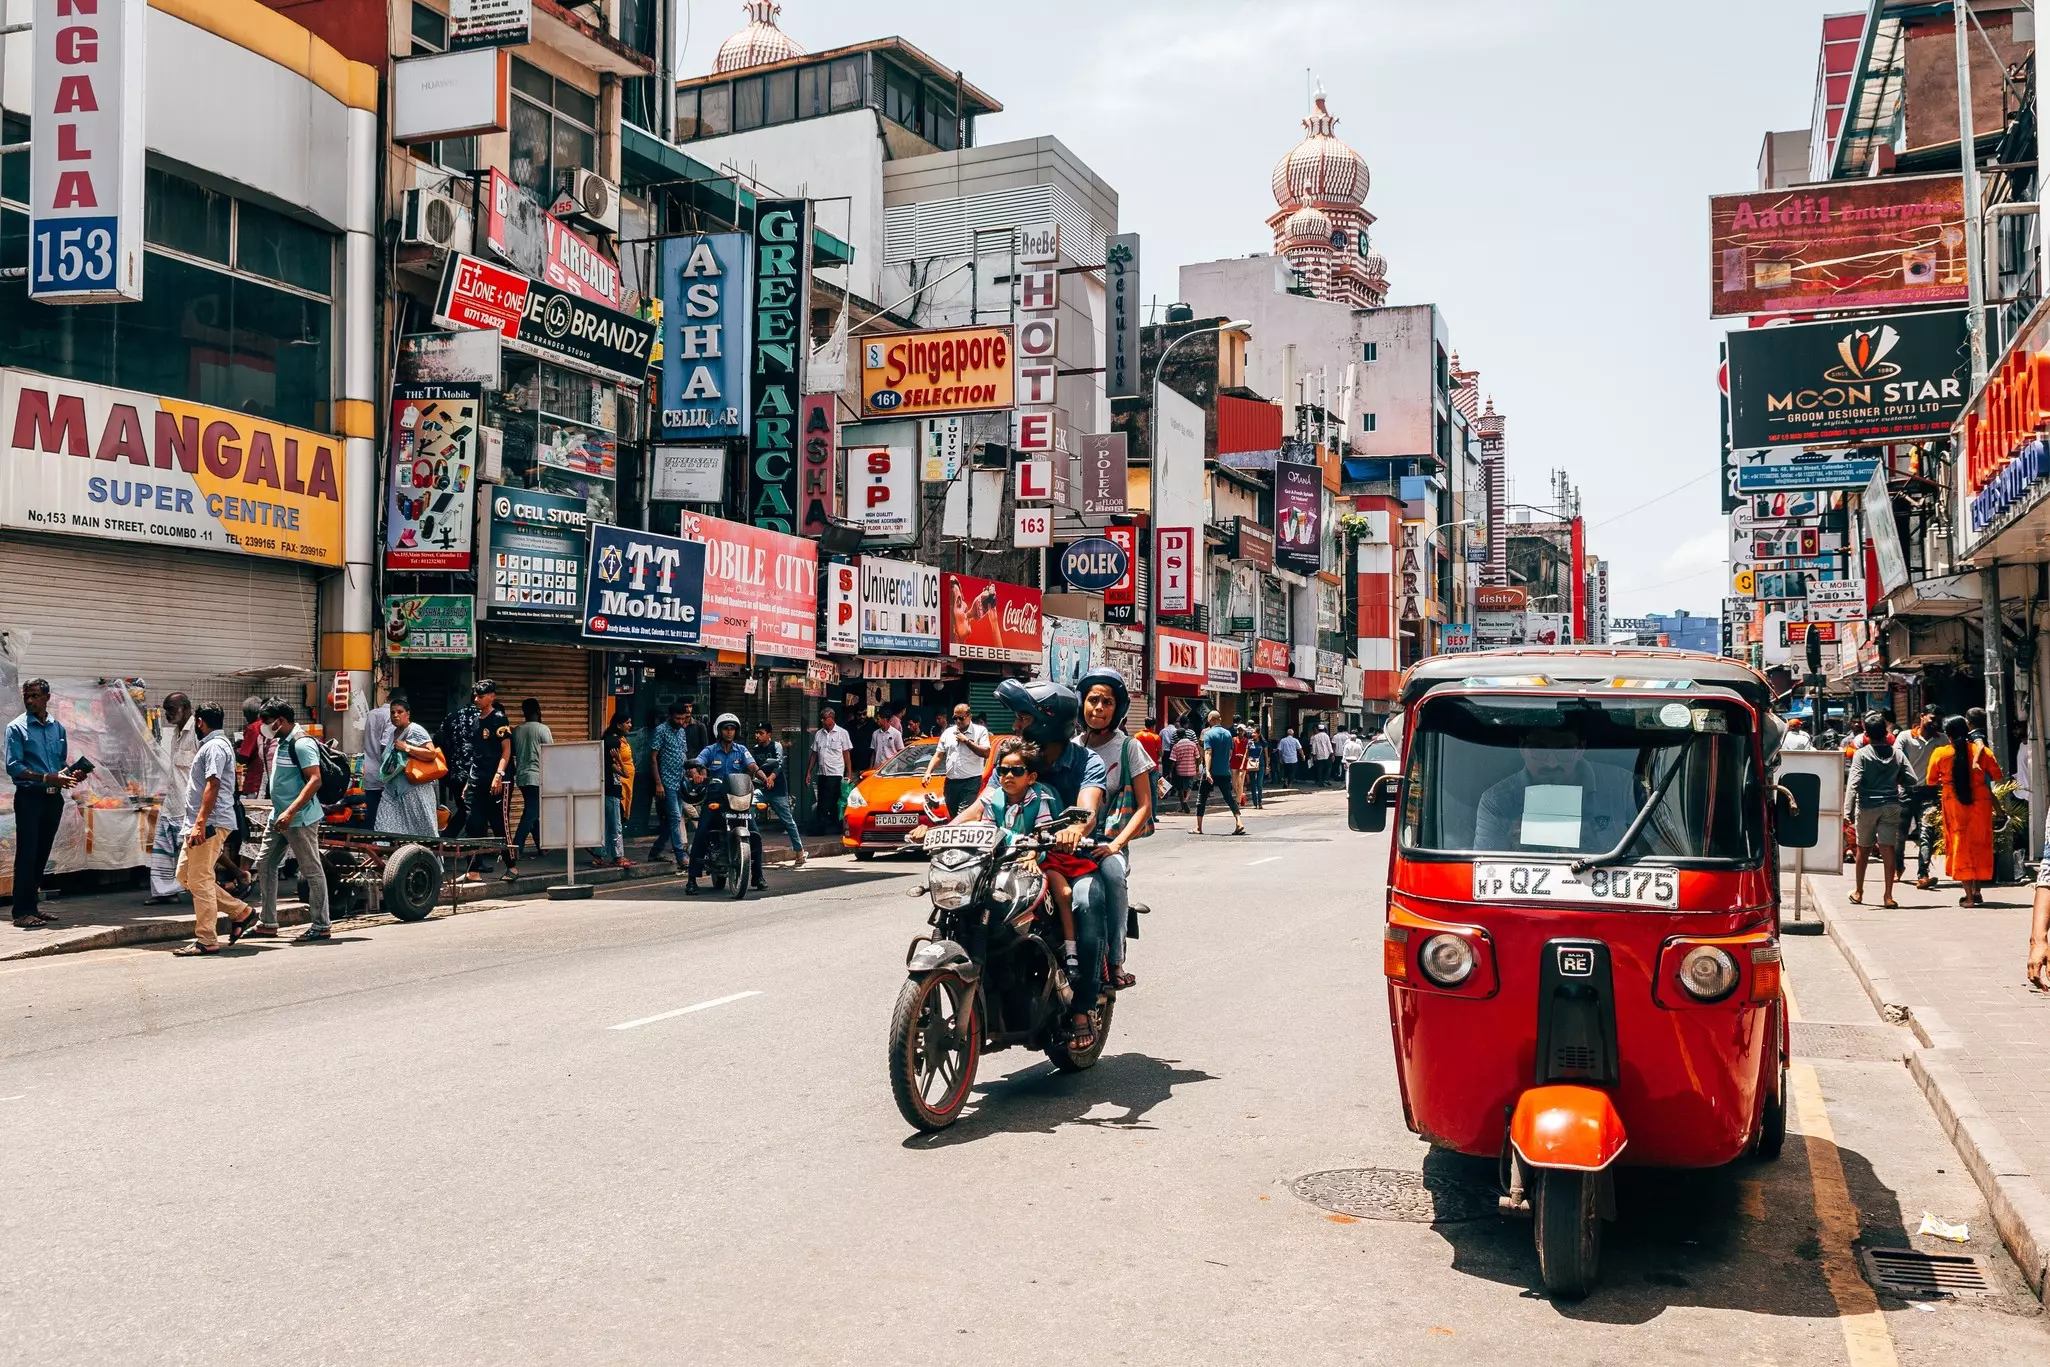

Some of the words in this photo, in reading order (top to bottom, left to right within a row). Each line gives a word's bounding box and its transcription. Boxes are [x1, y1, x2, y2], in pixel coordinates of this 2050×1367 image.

[552, 200, 573, 214] 155
[1732, 195, 1832, 231] Aadil
[1841, 198, 1962, 221] Enterprises
[37, 227, 113, 283] 153
[1022, 230, 1056, 256] BeeBe
[559, 229, 617, 305] ARCADE
[475, 281, 497, 304] ONE
[503, 290, 525, 313] ONE
[757, 209, 799, 375] GREEN
[570, 309, 649, 359] BRANDZ
[680, 242, 723, 400] ASHA
[533, 334, 565, 351] BRANDED
[567, 345, 591, 360] STUDIO
[886, 335, 1007, 388] Singapore
[442, 390, 471, 399] Mobile
[903, 384, 997, 408] SELECTION
[1020, 273, 1054, 498] HOTEL
[1767, 384, 1872, 412] MOON
[1883, 378, 1962, 403] STAR
[876, 393, 897, 406] 161
[1787, 412, 1825, 424] GROOM
[1828, 407, 1882, 420] DESIGNER
[1919, 402, 1940, 414] LTD
[11, 387, 340, 503] MANGALA
[805, 405, 832, 527] ASHA
[1096, 449, 1111, 498] POLEK
[87, 476, 195, 515] SUPER
[205, 492, 301, 532] CENTRE
[513, 503, 546, 521] CELL
[546, 508, 587, 527] STORE
[1102, 498, 1124, 506] FLOOR
[72, 514, 100, 529] MAIN
[103, 517, 147, 536] STREET,
[150, 523, 198, 540] COLOMBO
[225, 532, 243, 547] TEL:
[245, 536, 276, 551] 2399165
[281, 540, 299, 555] FAX:
[300, 543, 328, 559] 2399167
[683, 513, 701, 534] MC
[1020, 518, 1045, 534] 163
[626, 541, 681, 594] TT
[775, 552, 818, 597] CITY
[1067, 553, 1119, 576] POLEK
[1165, 536, 1184, 589] DSI
[1803, 561, 1830, 570] Wrap
[861, 563, 919, 607] Univercell
[922, 573, 938, 609] OG
[1108, 591, 1131, 601] MOBILE
[1829, 579, 1859, 589] MOBILE
[599, 589, 696, 623] Mobile
[1732, 611, 1751, 622] 176
[593, 619, 606, 630] 155
[723, 616, 749, 628] SONY
[959, 645, 985, 659] BEE
[988, 647, 1011, 660] BEE
[1447, 635, 1470, 646] BEST
[1169, 641, 1198, 670] DSI
[881, 816, 897, 825] CAD
[899, 815, 918, 824] 4262
[1509, 866, 1552, 895] QZ
[1591, 869, 1674, 901] 8075
[1564, 957, 1588, 971] RE
